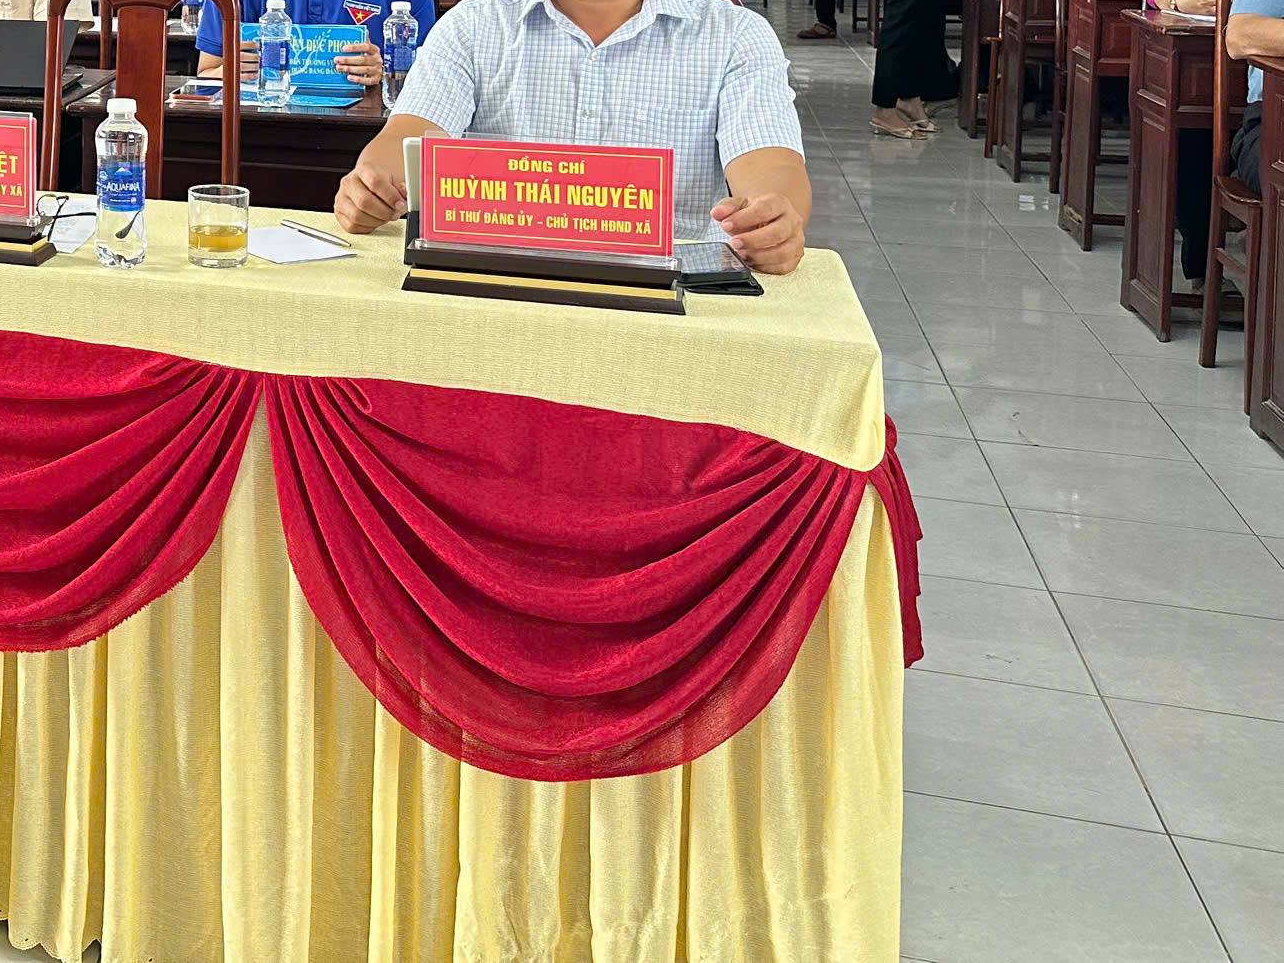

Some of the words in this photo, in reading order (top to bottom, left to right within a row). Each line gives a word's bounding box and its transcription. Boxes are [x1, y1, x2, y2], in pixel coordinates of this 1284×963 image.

[508, 155, 553, 173] ĐỒNG
[558, 160, 585, 175] CHÍ
[9, 183, 23, 197] XÃ
[106, 181, 141, 193] AQUAFINA
[440, 175, 507, 201] HUỲNH
[514, 179, 560, 205] THÁI
[567, 184, 654, 210] NGUYÊN
[445, 208, 456, 222] BÍ
[459, 209, 481, 223] THƯ
[484, 209, 515, 226] ĐẢNG
[517, 210, 534, 227] ỦY
[546, 213, 569, 229] CHỦ
[573, 217, 598, 233] TỊCH
[600, 220, 632, 233] HĐND
[635, 219, 652, 235] XÃ
